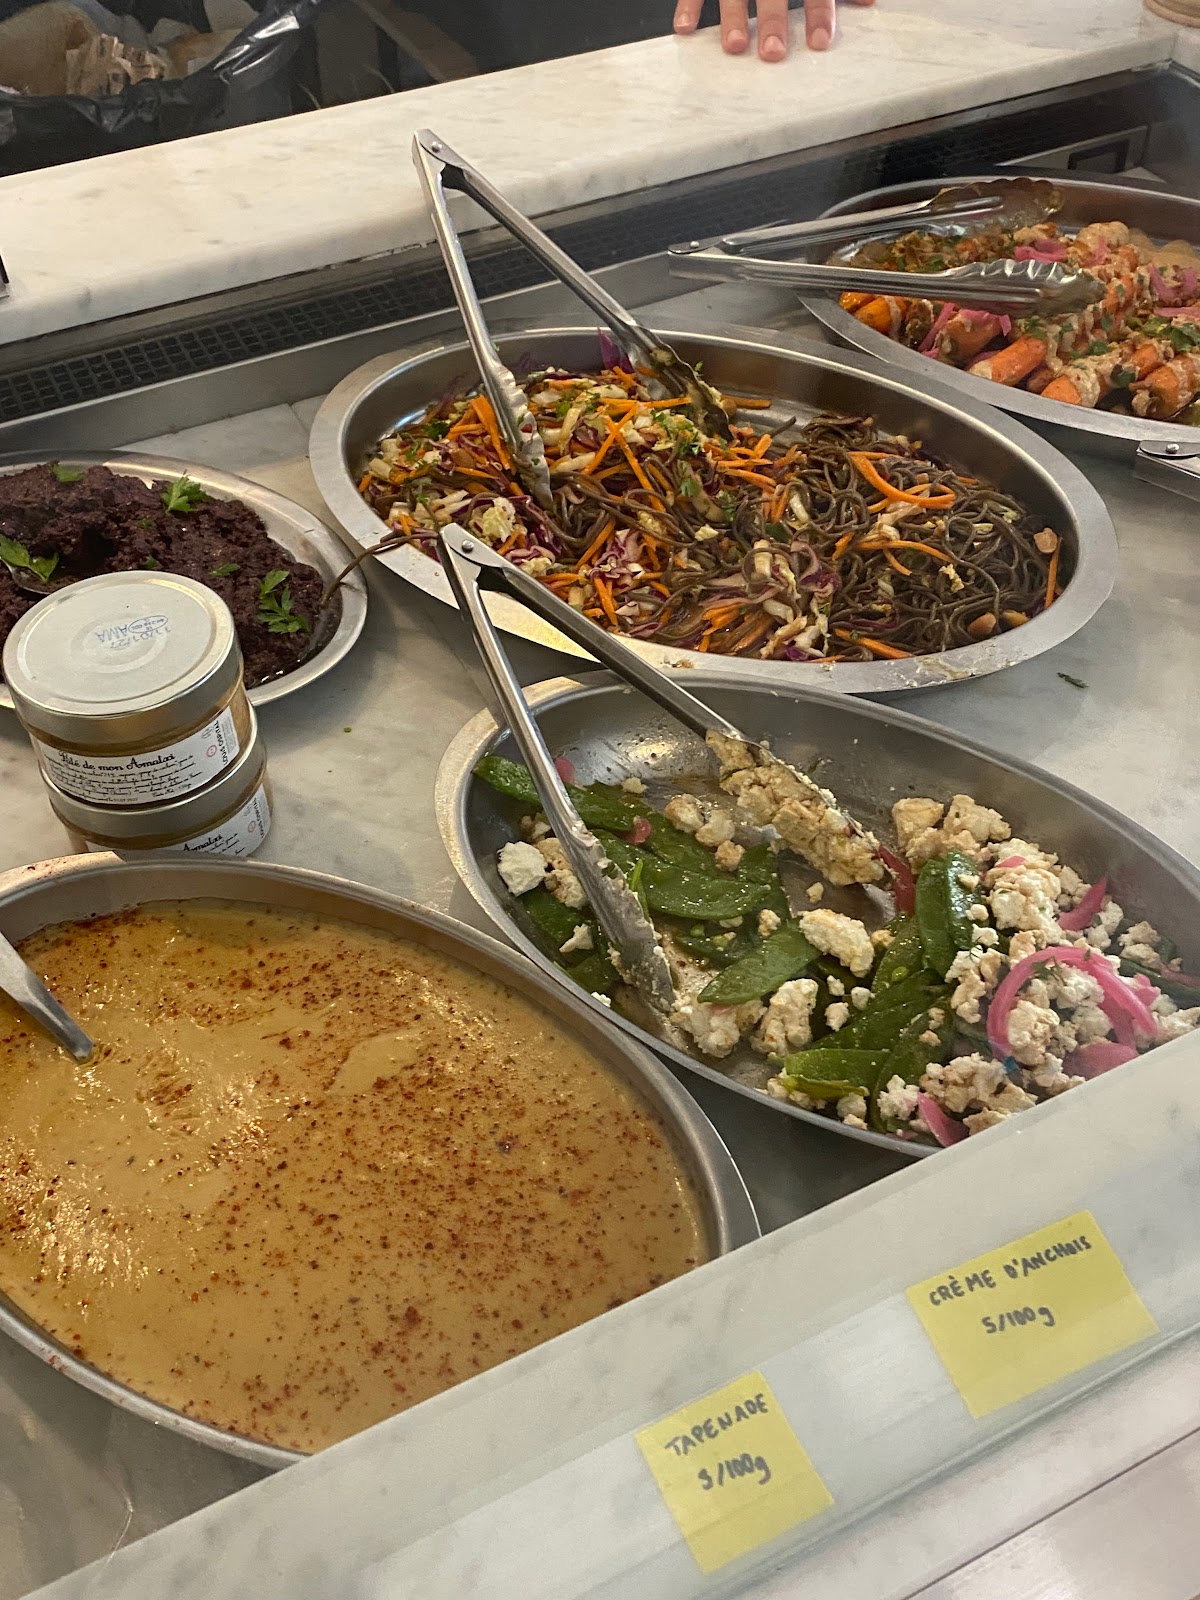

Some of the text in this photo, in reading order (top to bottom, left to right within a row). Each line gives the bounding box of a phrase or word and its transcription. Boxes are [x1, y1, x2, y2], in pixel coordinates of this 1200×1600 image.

[82, 760, 96, 770] de
[929, 1235, 1092, 1306] CRÈME D'ANCHOIS
[664, 1393, 768, 1456] TAPENADE
